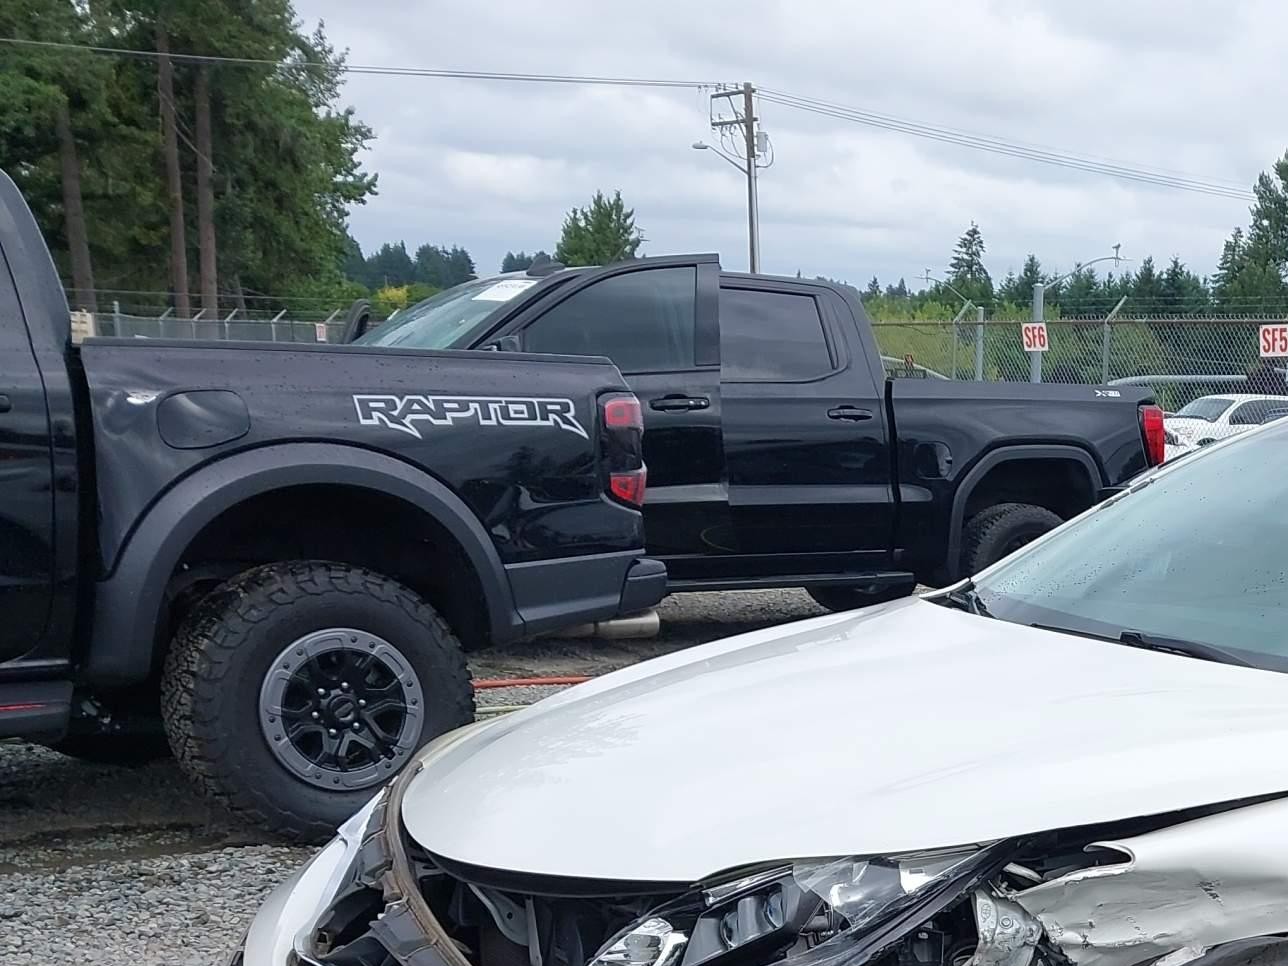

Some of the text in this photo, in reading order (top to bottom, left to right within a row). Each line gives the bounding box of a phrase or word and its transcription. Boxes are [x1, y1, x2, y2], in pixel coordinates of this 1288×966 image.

[1024, 326, 1046, 348] SF6
[1262, 327, 1288, 353] SF5
[352, 394, 590, 440] RAPTOR
